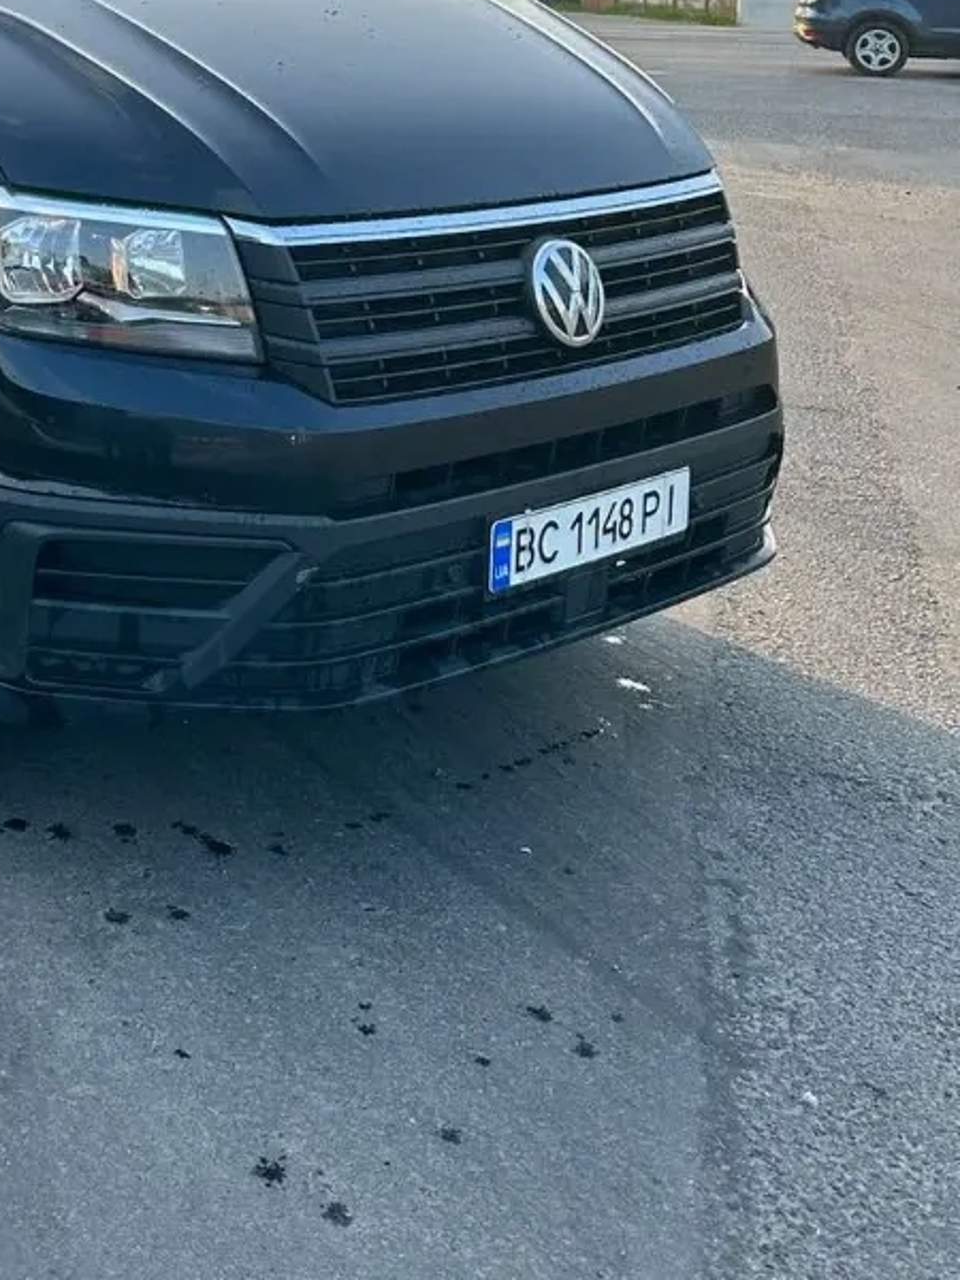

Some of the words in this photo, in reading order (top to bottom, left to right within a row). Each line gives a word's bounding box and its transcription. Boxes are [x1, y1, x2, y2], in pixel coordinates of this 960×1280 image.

[533, 240, 604, 347] VW
[515, 521, 559, 573] BC
[570, 498, 634, 555] 1148
[641, 485, 675, 535] PI
